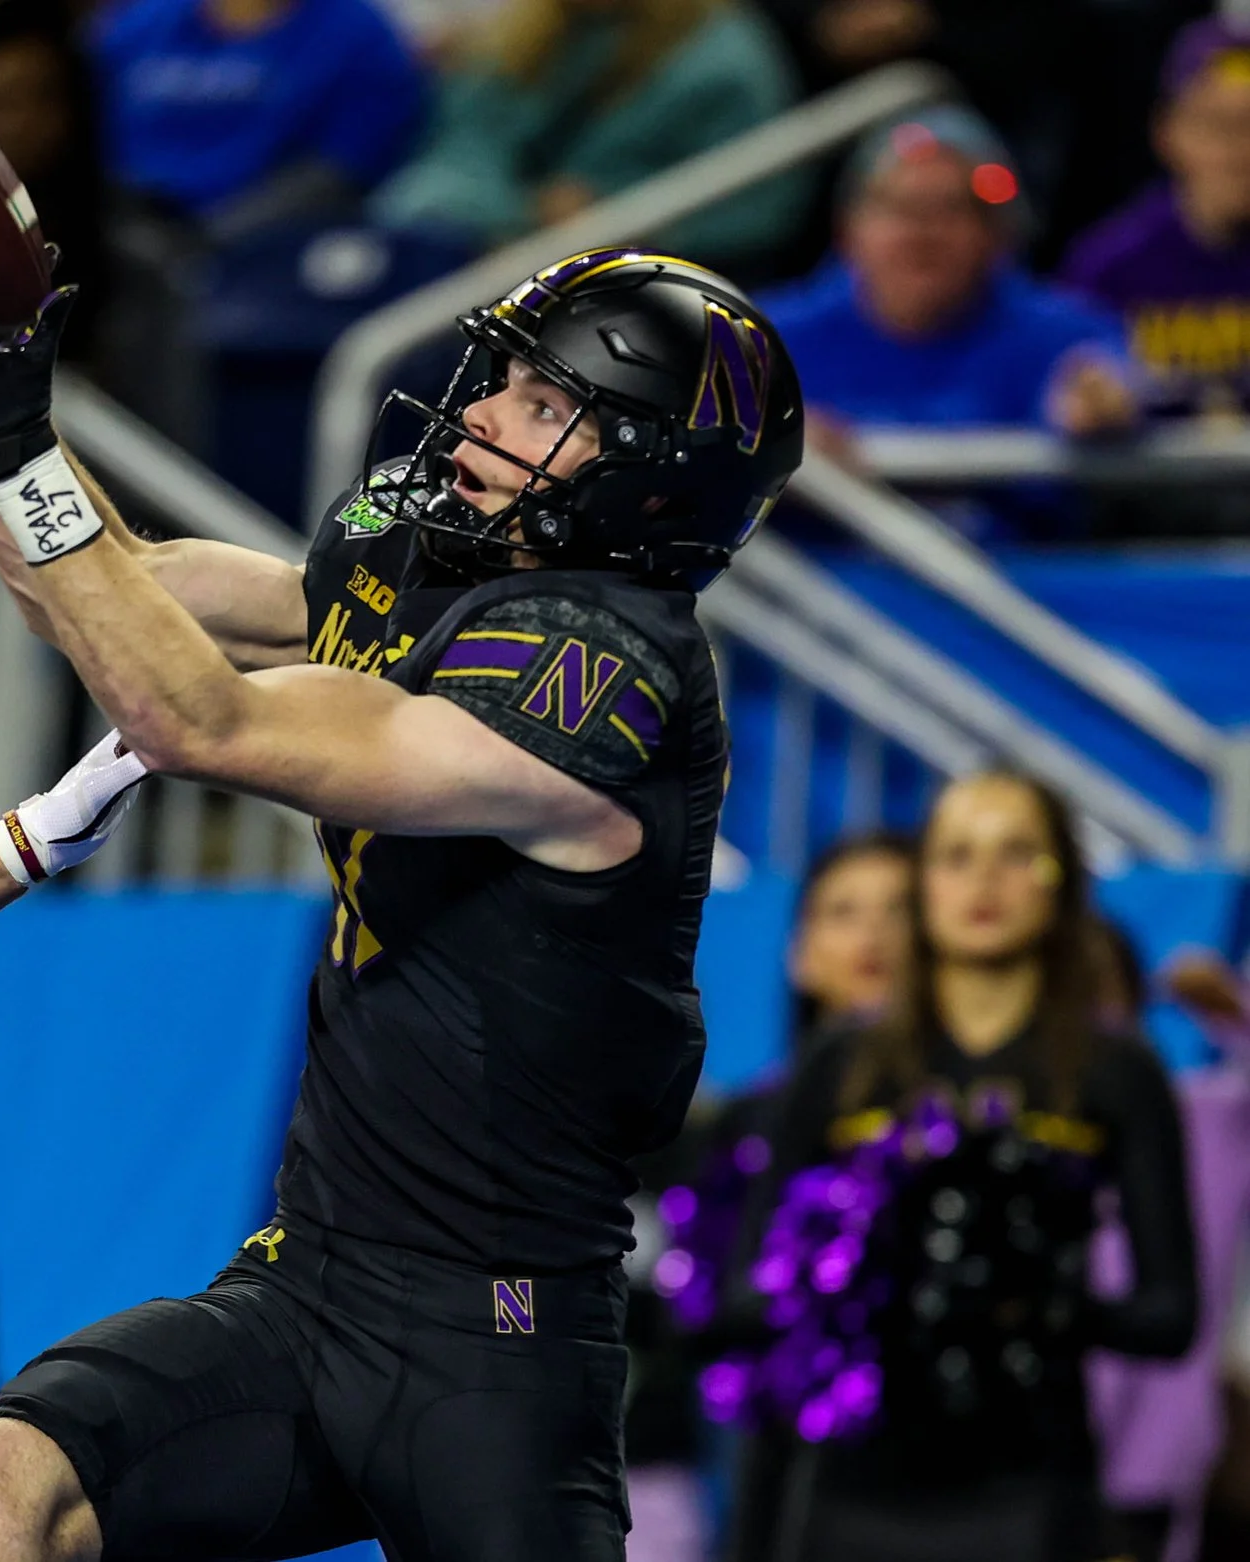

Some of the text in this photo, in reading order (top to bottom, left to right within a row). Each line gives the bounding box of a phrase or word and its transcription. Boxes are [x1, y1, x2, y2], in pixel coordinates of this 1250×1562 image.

[688, 303, 768, 455] N
[48, 490, 83, 527] 27
[520, 638, 624, 735] N
[493, 1279, 535, 1333] N
